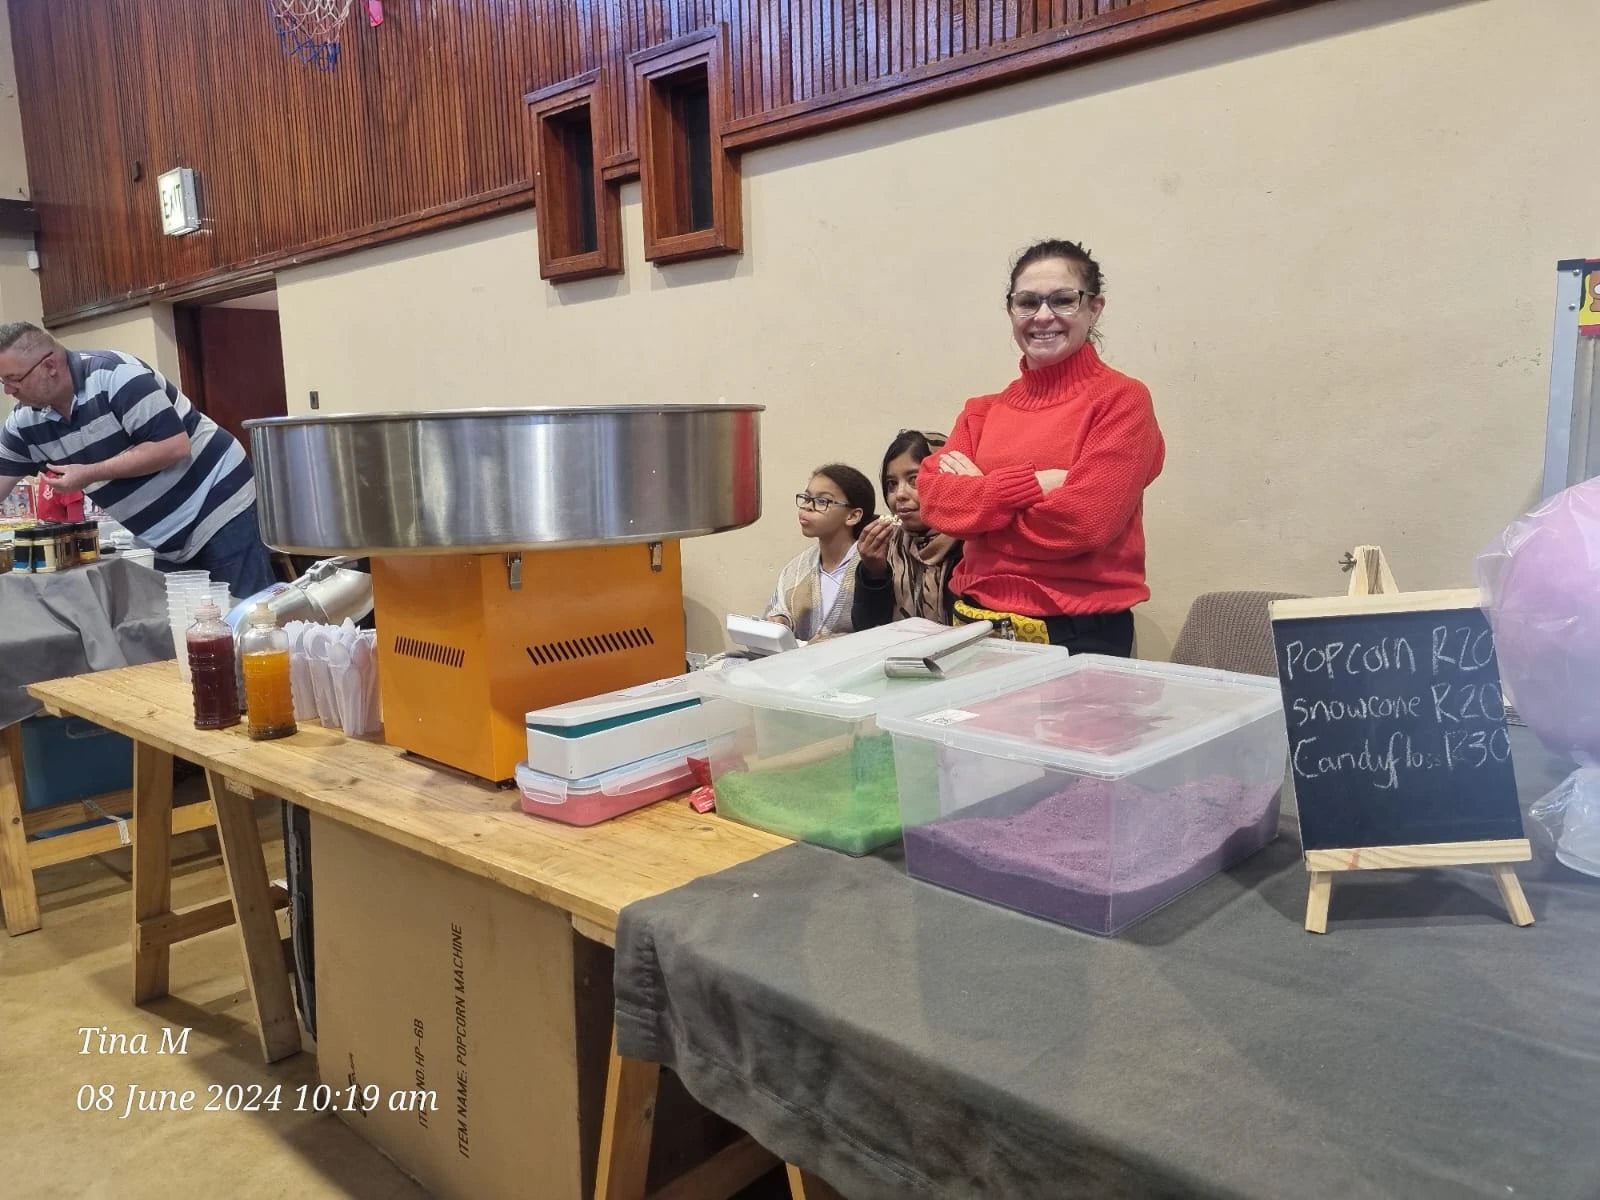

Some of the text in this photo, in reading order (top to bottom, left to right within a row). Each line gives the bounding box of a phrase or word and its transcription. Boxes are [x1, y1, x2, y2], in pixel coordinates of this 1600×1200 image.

[1432, 625, 1495, 675] R20
[1431, 680, 1505, 723] R20
[1444, 727, 1511, 770] R30
[451, 922, 470, 1159] ITEM NAME: POPCORN MACHINE
